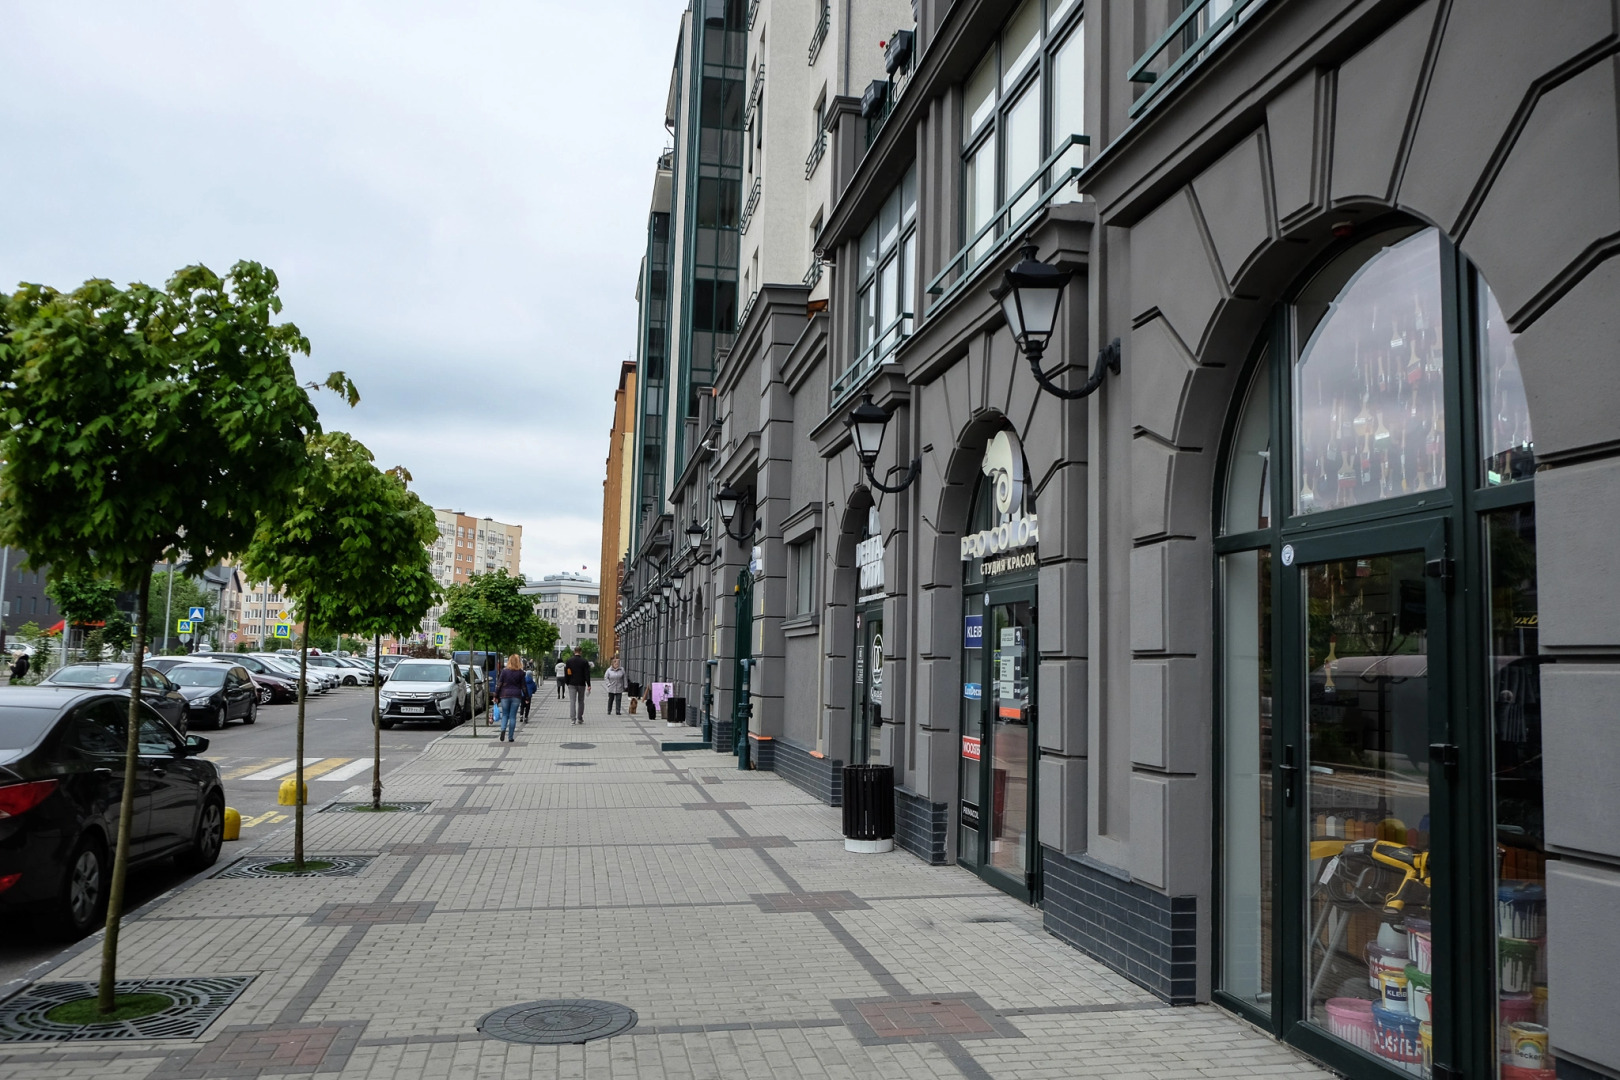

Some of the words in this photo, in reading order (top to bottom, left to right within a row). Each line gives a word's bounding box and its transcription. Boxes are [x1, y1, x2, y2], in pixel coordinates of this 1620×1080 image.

[980, 559, 1006, 576] СТУДИЯ
[1007, 552, 1036, 571] КРАСОК
[966, 625, 983, 638] KLEIB
